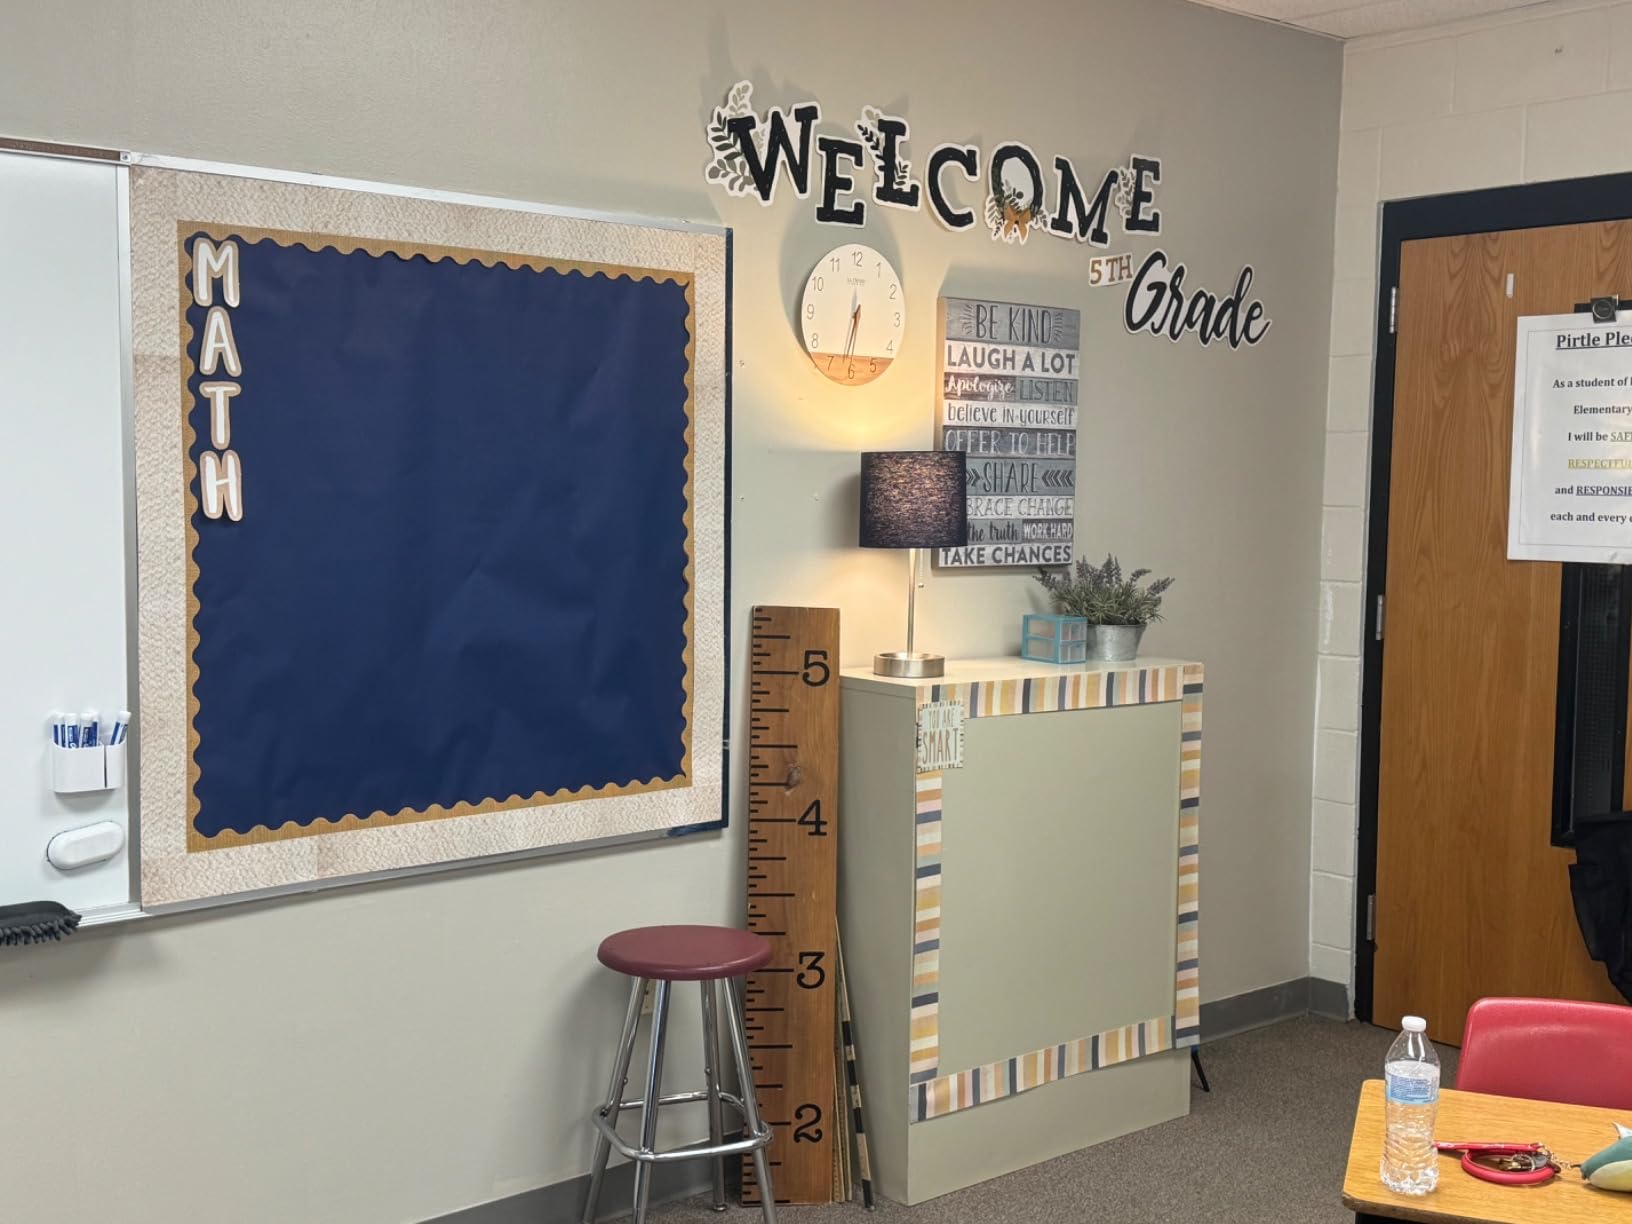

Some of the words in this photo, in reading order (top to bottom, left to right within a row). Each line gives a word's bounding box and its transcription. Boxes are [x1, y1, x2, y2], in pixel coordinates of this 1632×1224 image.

[728, 105, 1161, 246] WELCOME
[830, 258, 840, 272] 11
[852, 252, 863, 267] 12
[876, 262, 882, 278] 1
[812, 276, 824, 291] 10
[889, 284, 897, 300] 2
[1126, 251, 1271, 349] Grade
[807, 304, 815, 319] 9
[894, 312, 901, 327] 3
[976, 304, 998, 339] BE
[1009, 306, 1051, 344] KIND
[812, 333, 819, 348] 8
[887, 340, 893, 355] 4
[1556, 333, 1601, 349] Pirtle
[1606, 331, 1632, 347] Ple
[827, 356, 834, 371] 7
[870, 357, 877, 373] 5
[947, 345, 1016, 370] LAUGH
[1022, 351, 1035, 372] A
[1041, 352, 1075, 374] LOT
[194, 238, 243, 521] MATH
[848, 364, 855, 379] 6
[945, 375, 1016, 400] Apologize
[1019, 379, 1074, 402] LISTEN
[1553, 379, 1565, 388] As
[1567, 380, 1573, 388] a
[1576, 377, 1615, 387] student
[1617, 376, 1628, 387] of
[948, 403, 997, 423] believe
[1574, 404, 1632, 416] Elementary
[945, 429, 1000, 454] OFFER
[1009, 432, 1029, 455] TO
[1036, 432, 1074, 456] HELP
[1568, 432, 1571, 441] I
[1574, 431, 1593, 441] will
[1595, 431, 1608, 441] be
[983, 461, 1039, 493] SHARE
[1554, 485, 1573, 494] and
[967, 497, 1013, 516] BRACE
[1017, 497, 1073, 517] CHANGE
[1550, 512, 1573, 521] each
[1576, 512, 1595, 521] and
[1597, 514, 1627, 525] every
[967, 521, 984, 541] the
[989, 521, 1019, 541] truth
[1023, 523, 1048, 539] WORK
[1050, 523, 1073, 539] HARD
[942, 547, 985, 565] TAKE
[991, 545, 1072, 564] CHANCES
[803, 650, 830, 687] 5
[922, 728, 959, 764] SMART
[798, 800, 827, 836] 4
[797, 952, 826, 989] 3
[794, 1104, 823, 1143] 2
